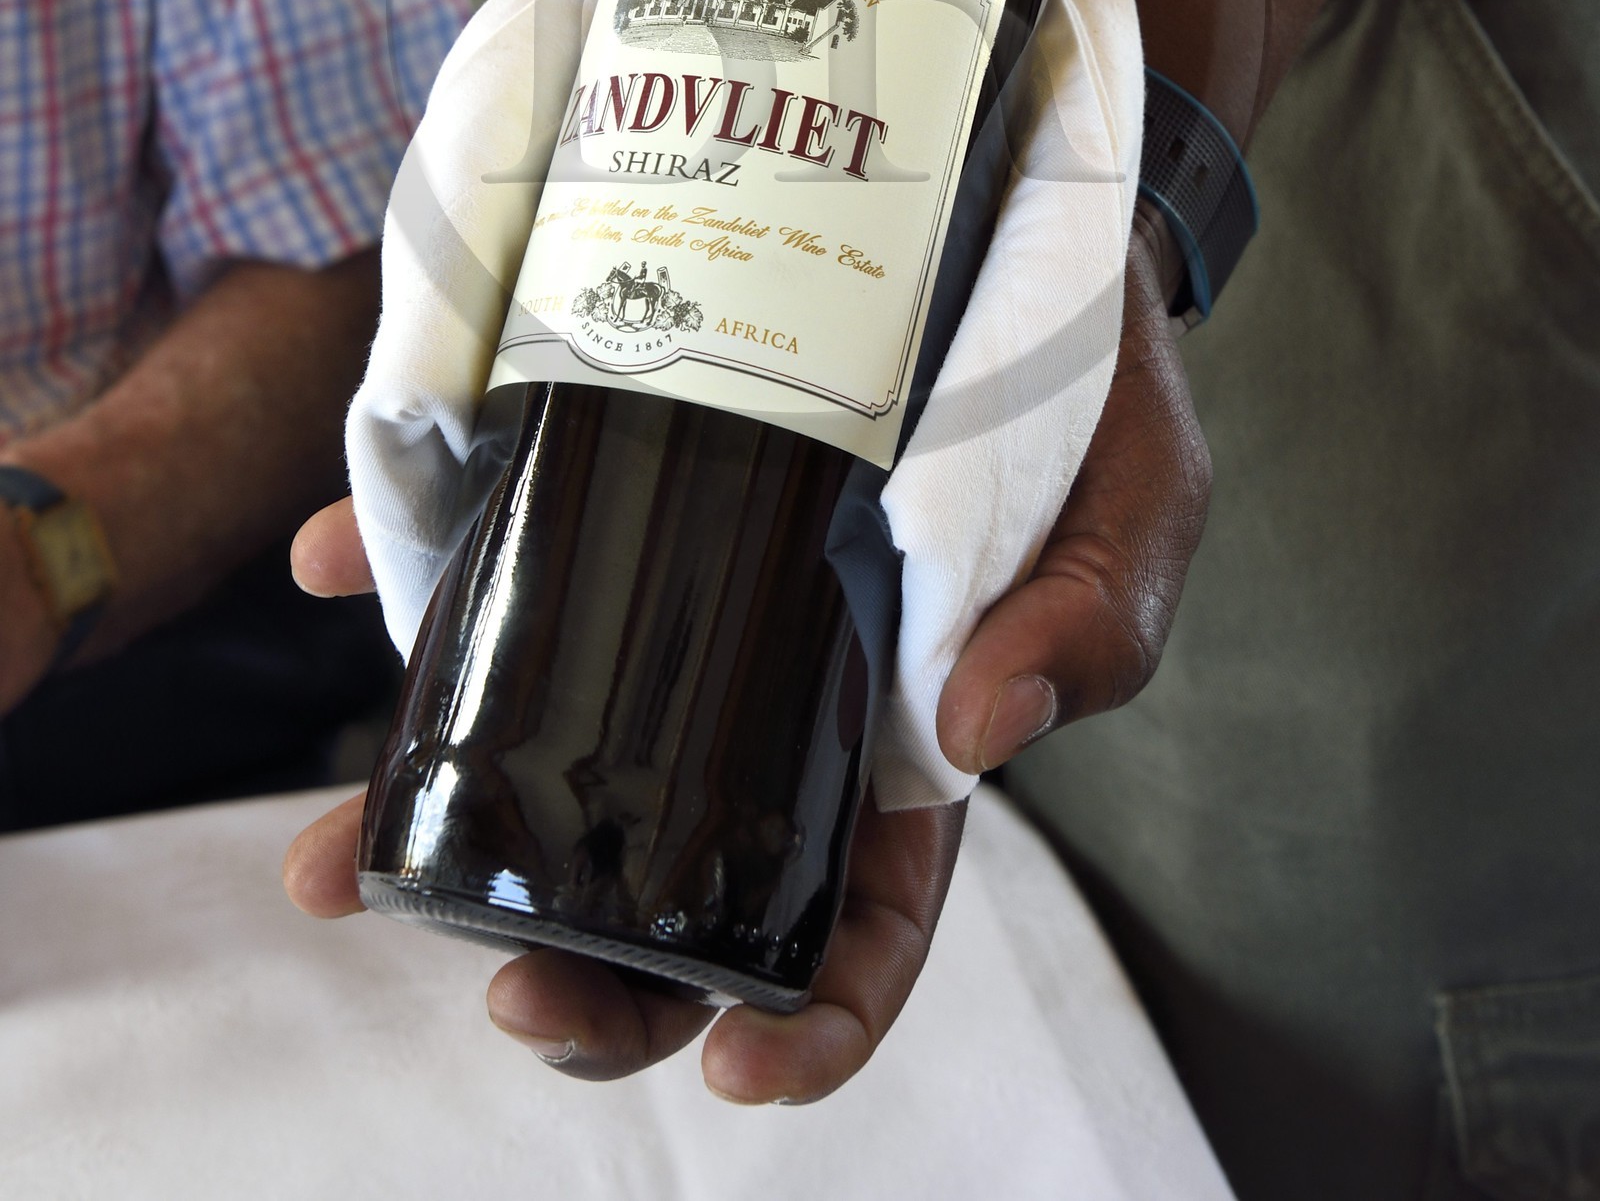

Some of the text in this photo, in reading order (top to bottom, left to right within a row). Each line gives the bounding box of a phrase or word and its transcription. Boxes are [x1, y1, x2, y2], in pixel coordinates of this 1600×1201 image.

[560, 72, 888, 182] ZANDVLIET
[608, 150, 742, 187] SHIRAZ
[631, 207, 652, 219] on
[653, 204, 679, 221] the
[681, 206, 770, 239] Zandvliet
[778, 226, 827, 256] Wine
[837, 244, 886, 279] Estate
[631, 225, 687, 248] South
[689, 235, 754, 262] Africa
[581, 321, 673, 353] SINCE 1867
[714, 317, 799, 355] AFRICA
